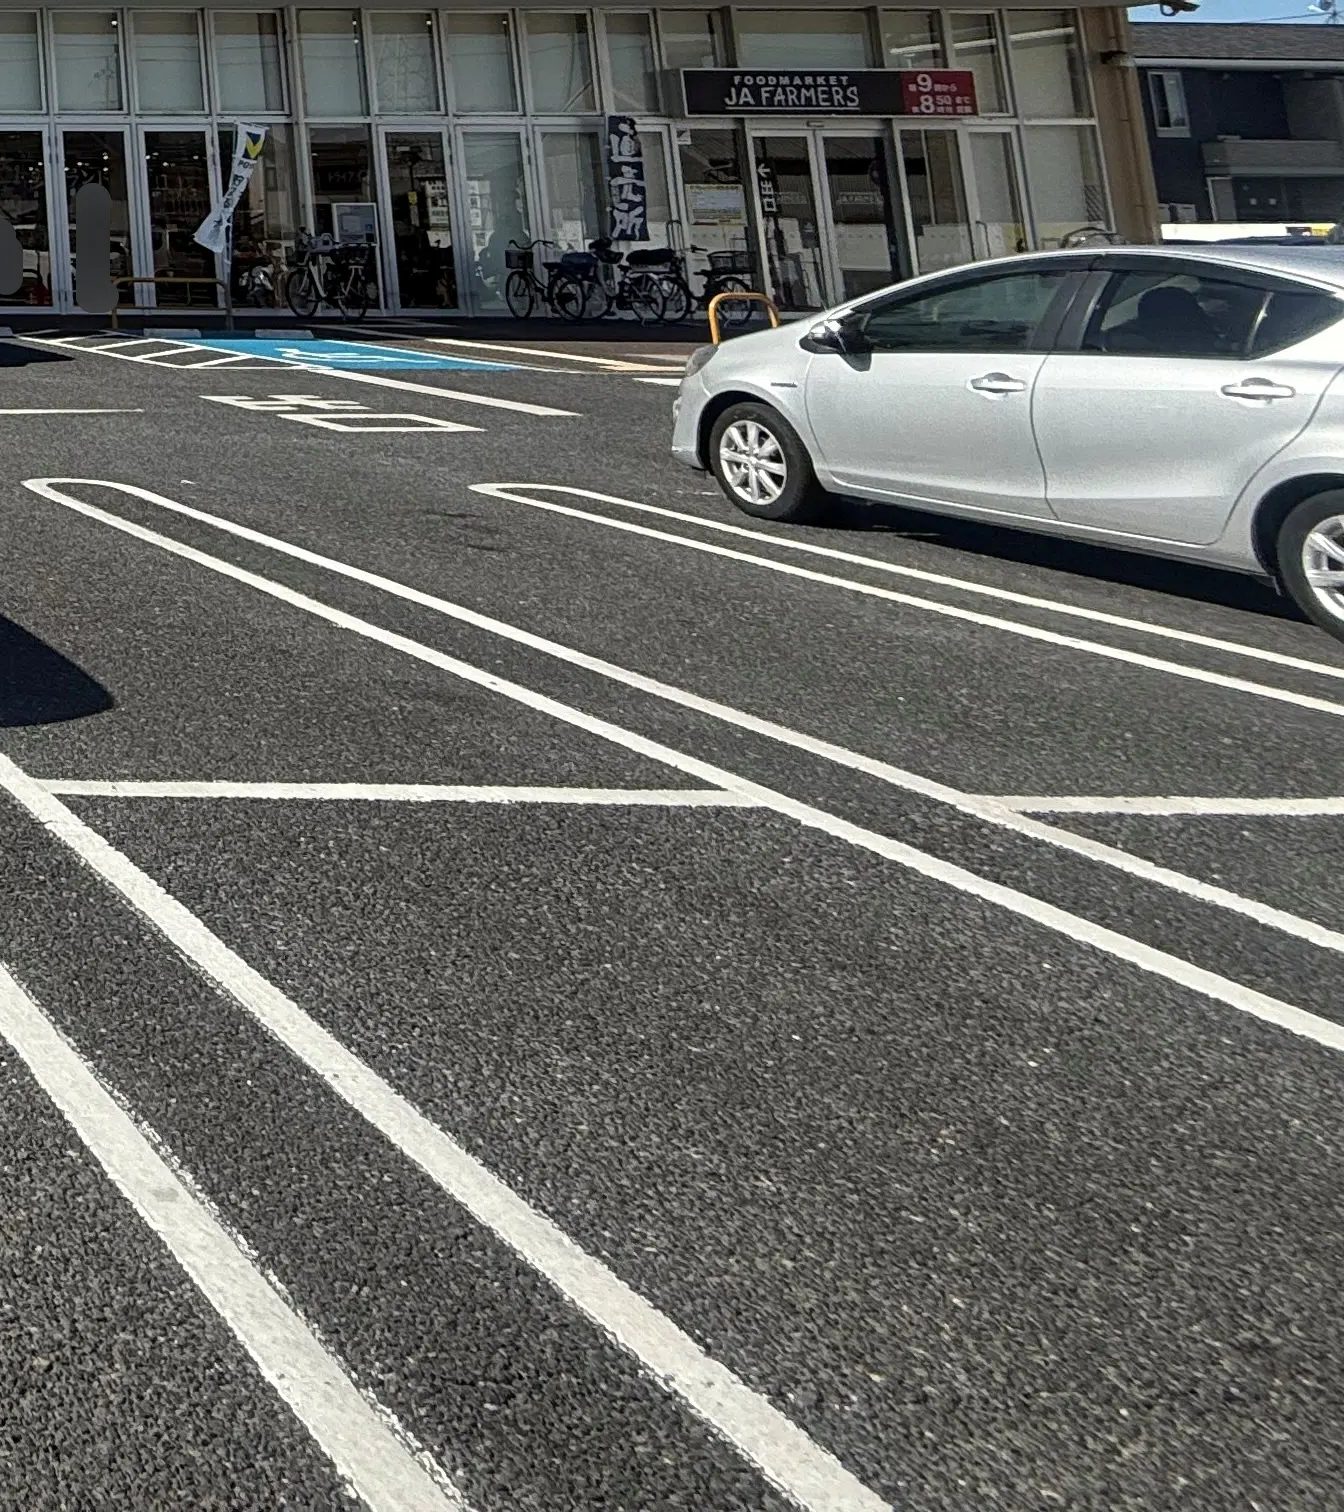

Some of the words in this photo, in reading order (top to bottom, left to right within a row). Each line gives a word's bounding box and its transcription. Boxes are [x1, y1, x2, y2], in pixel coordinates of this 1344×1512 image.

[733, 75, 849, 86] FOODMARKET
[724, 87, 755, 106] JA
[761, 86, 860, 107] FARMERS
